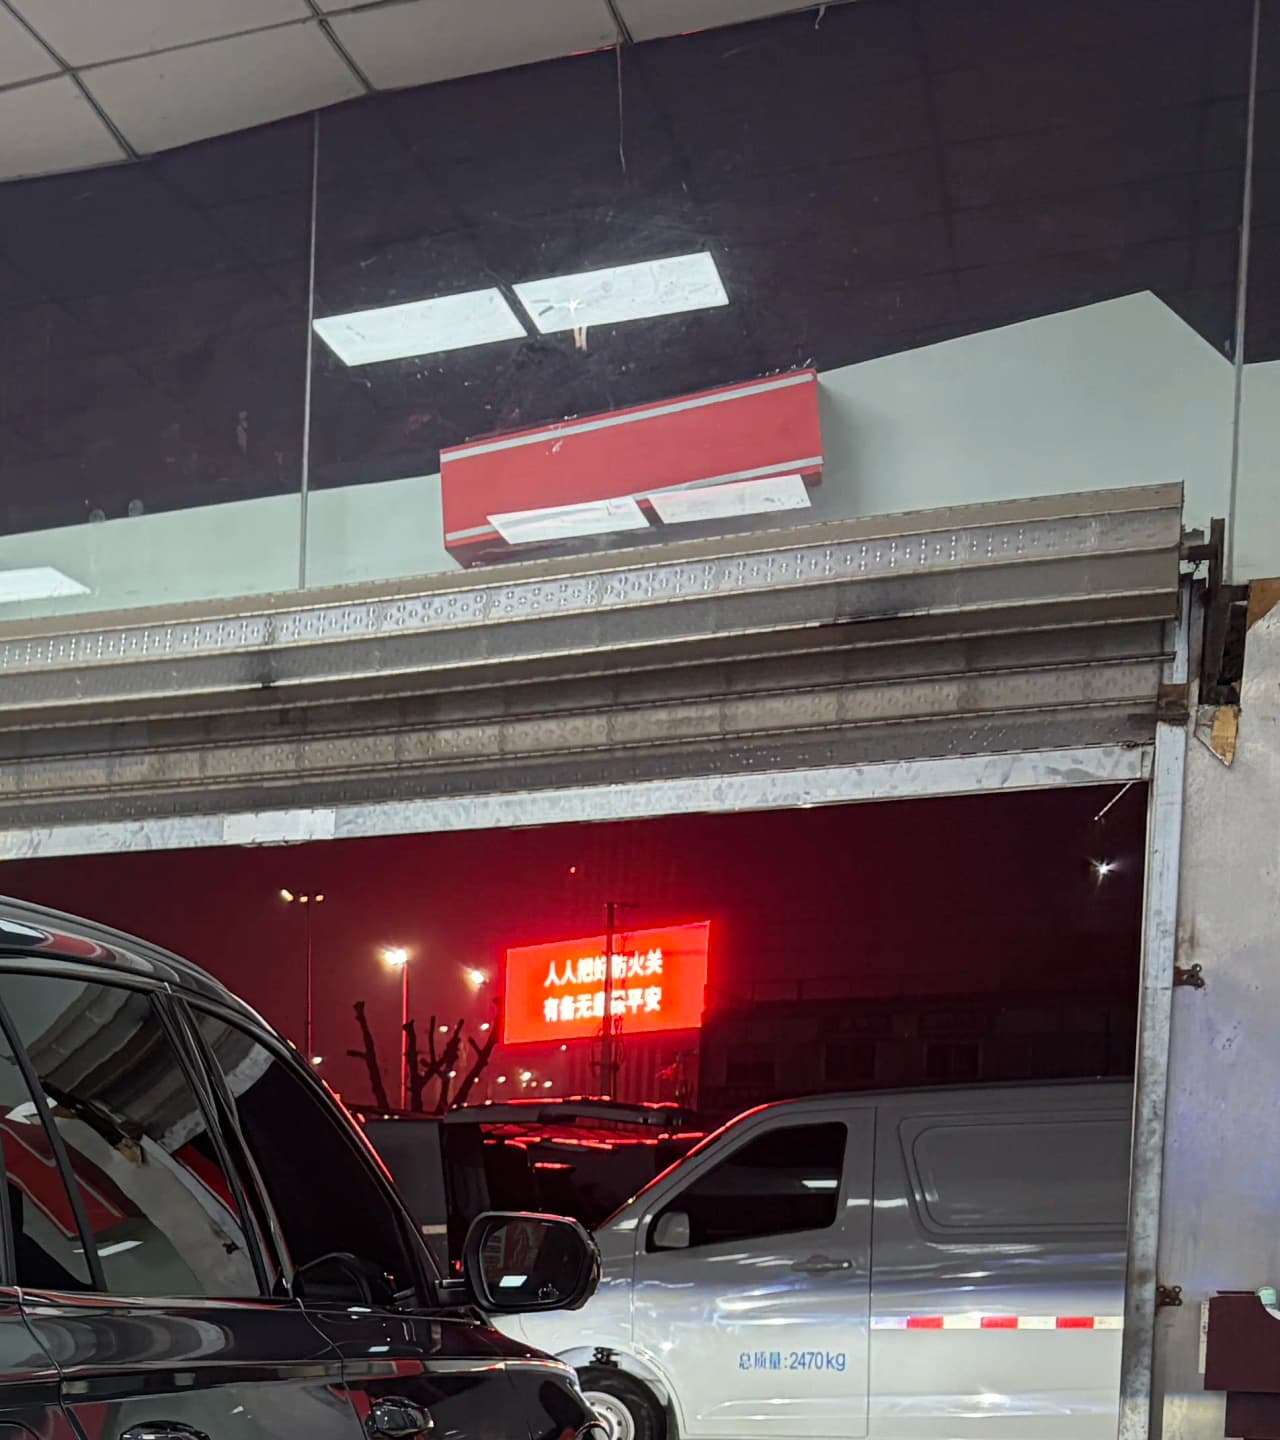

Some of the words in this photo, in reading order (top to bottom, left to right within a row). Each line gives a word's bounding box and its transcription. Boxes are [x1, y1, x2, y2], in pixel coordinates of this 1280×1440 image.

[544, 948, 663, 987] 人人把好防火关
